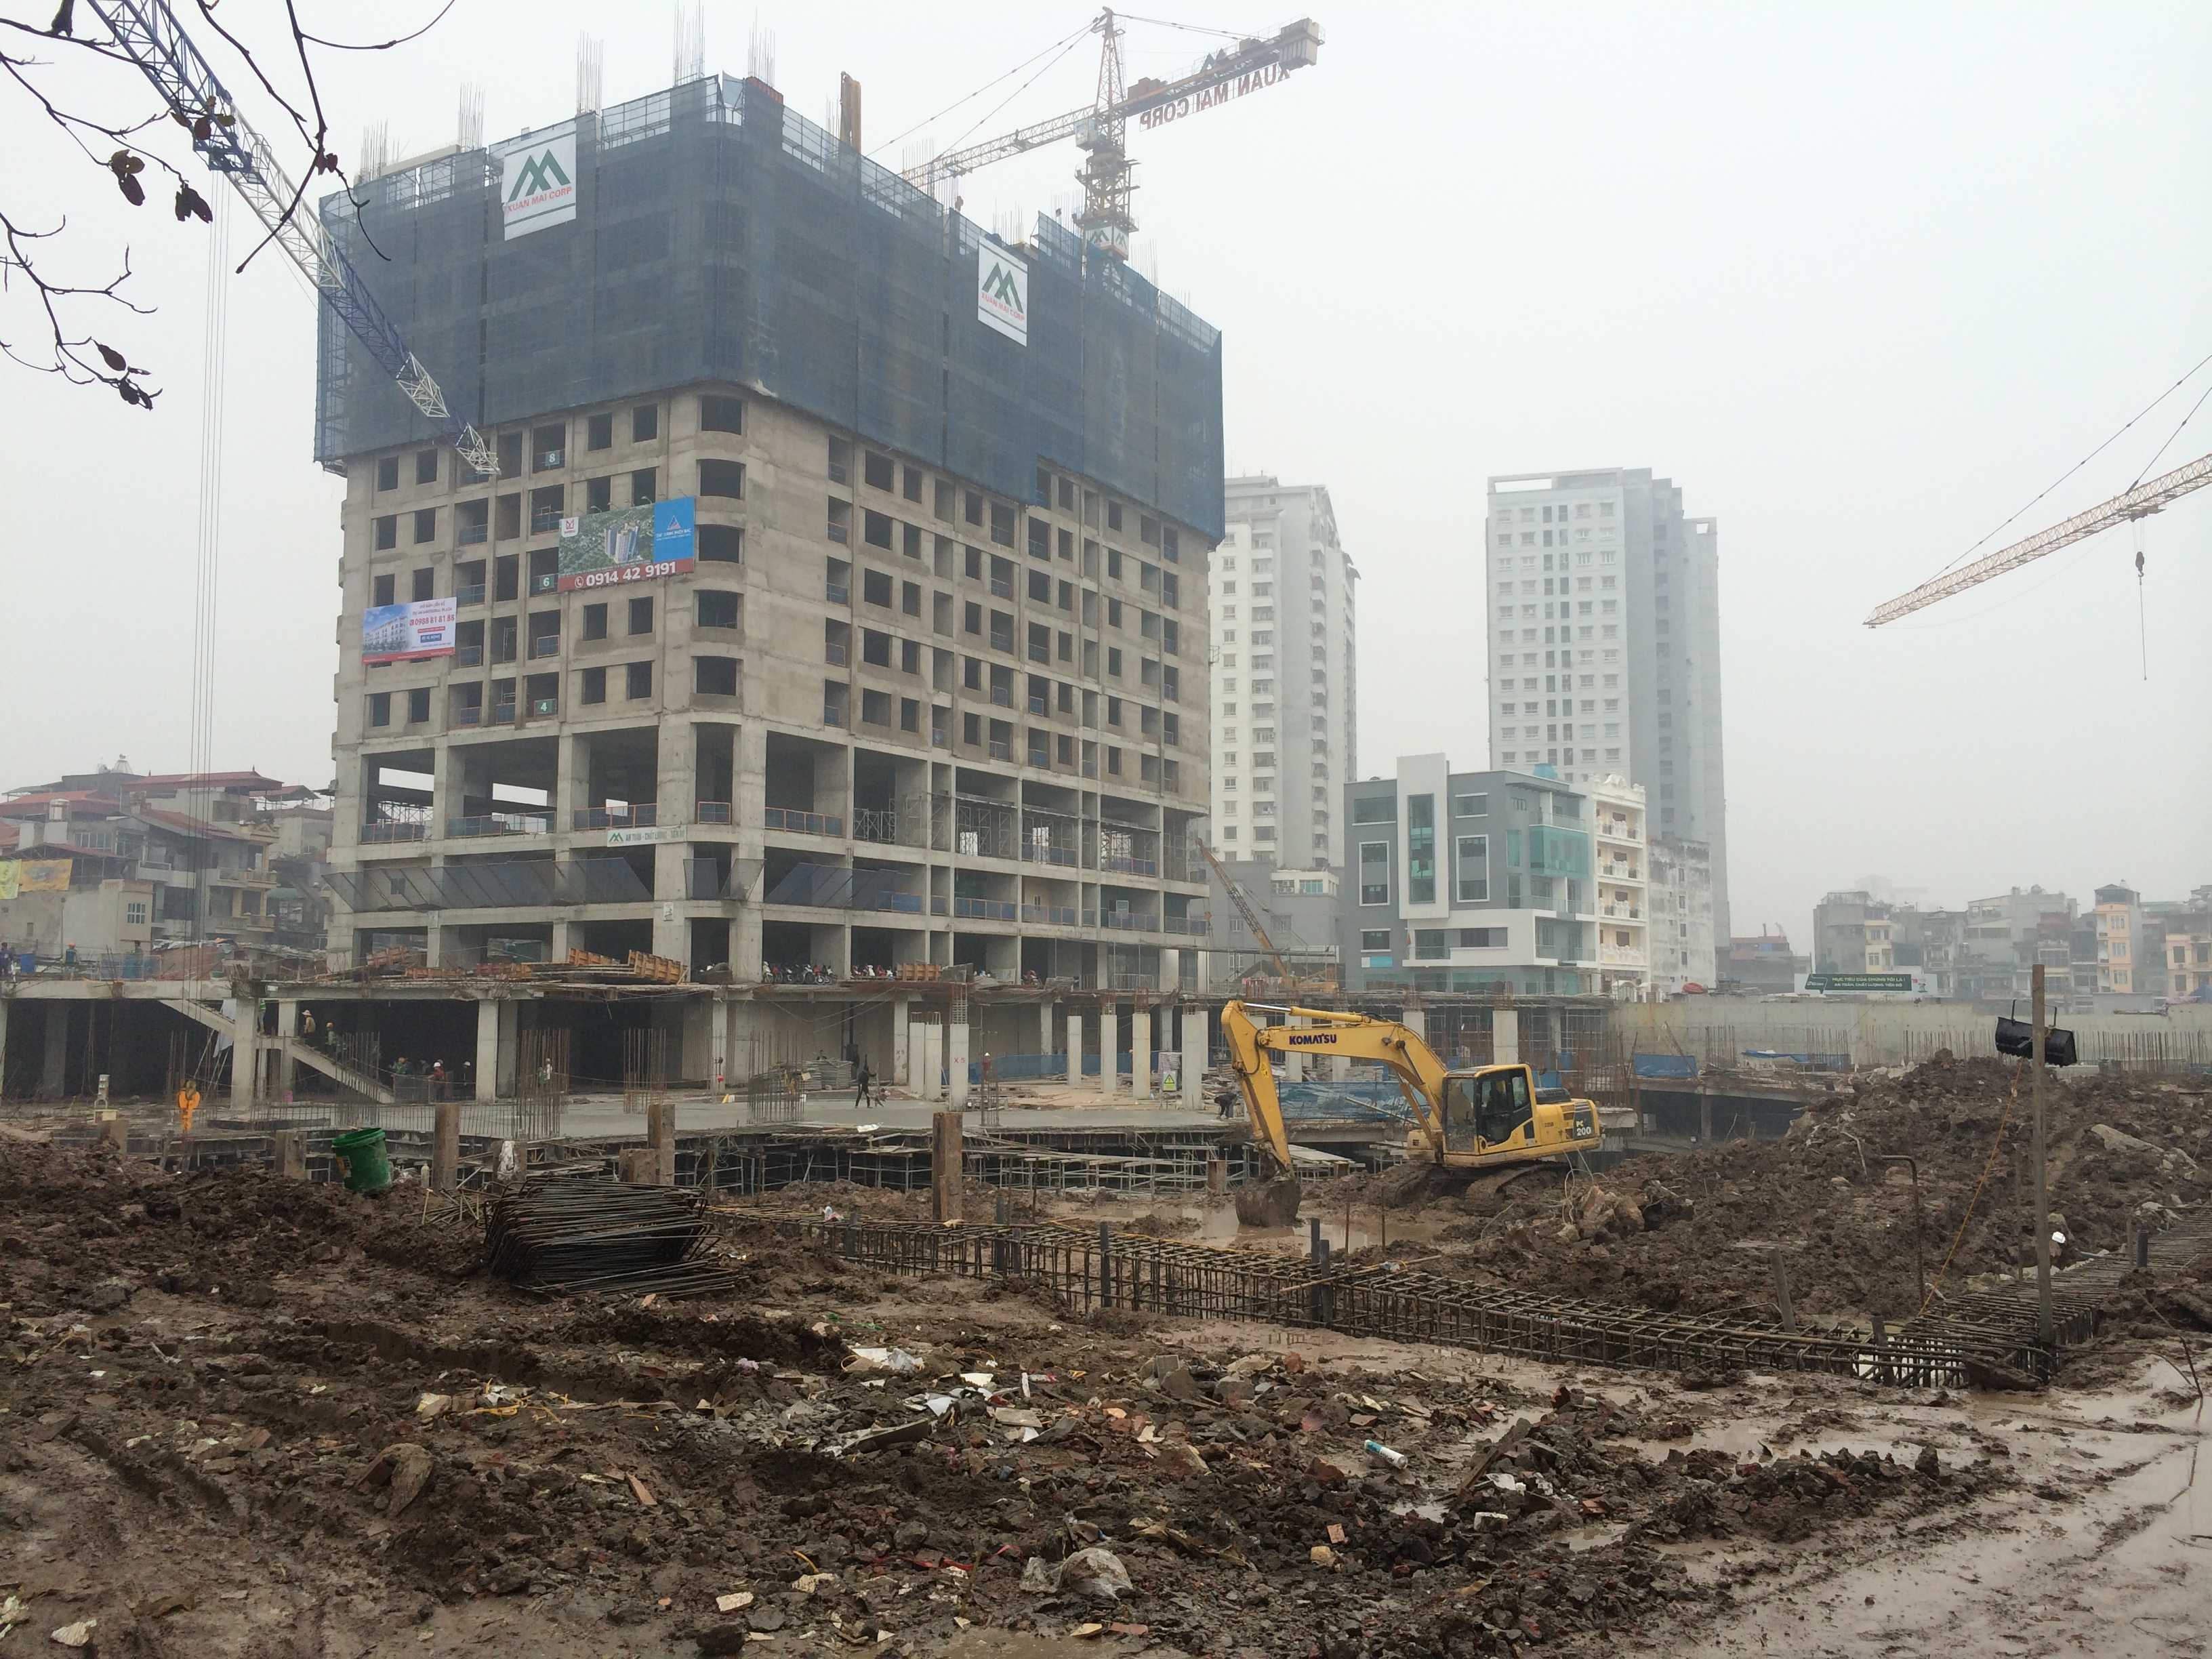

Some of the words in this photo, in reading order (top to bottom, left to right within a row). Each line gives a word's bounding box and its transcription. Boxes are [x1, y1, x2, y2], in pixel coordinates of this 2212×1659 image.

[531, 193, 547, 205] MAI
[549, 186, 572, 200] CORP
[549, 453, 556, 462] 8
[586, 571, 619, 586] 0914
[622, 567, 641, 581] 42
[644, 561, 676, 577] 9191
[543, 577, 550, 587] 6
[541, 701, 548, 712] 4
[1289, 1033, 1337, 1045] KOMATSU
[1576, 1126, 1591, 1136] 200
